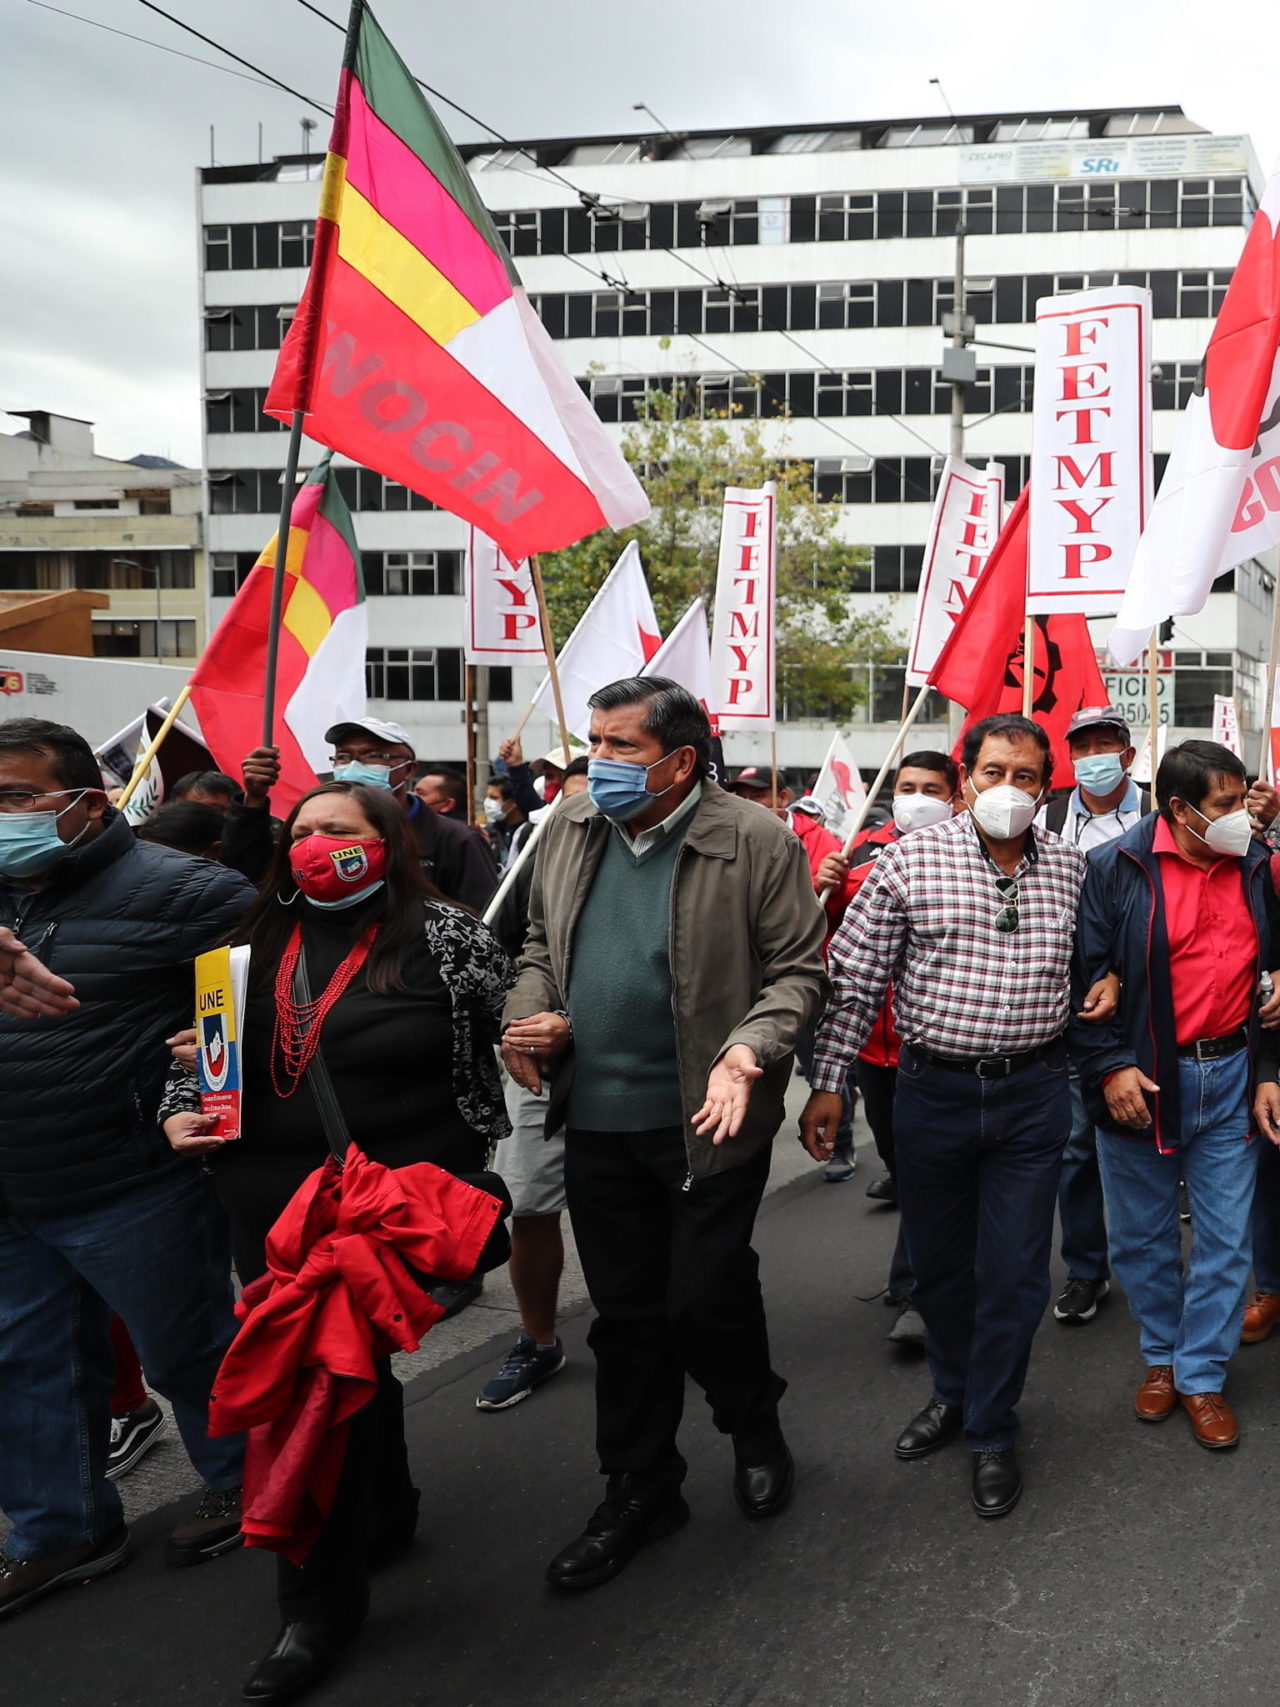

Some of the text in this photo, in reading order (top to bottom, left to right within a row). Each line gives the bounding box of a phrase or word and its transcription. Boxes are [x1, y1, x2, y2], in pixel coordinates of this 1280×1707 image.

[321, 319, 545, 524] NOCIN
[1050, 318, 1117, 579] FETMYP
[726, 511, 761, 705] FETMYP
[331, 847, 363, 860] UNE
[200, 989, 225, 1012] UNE
